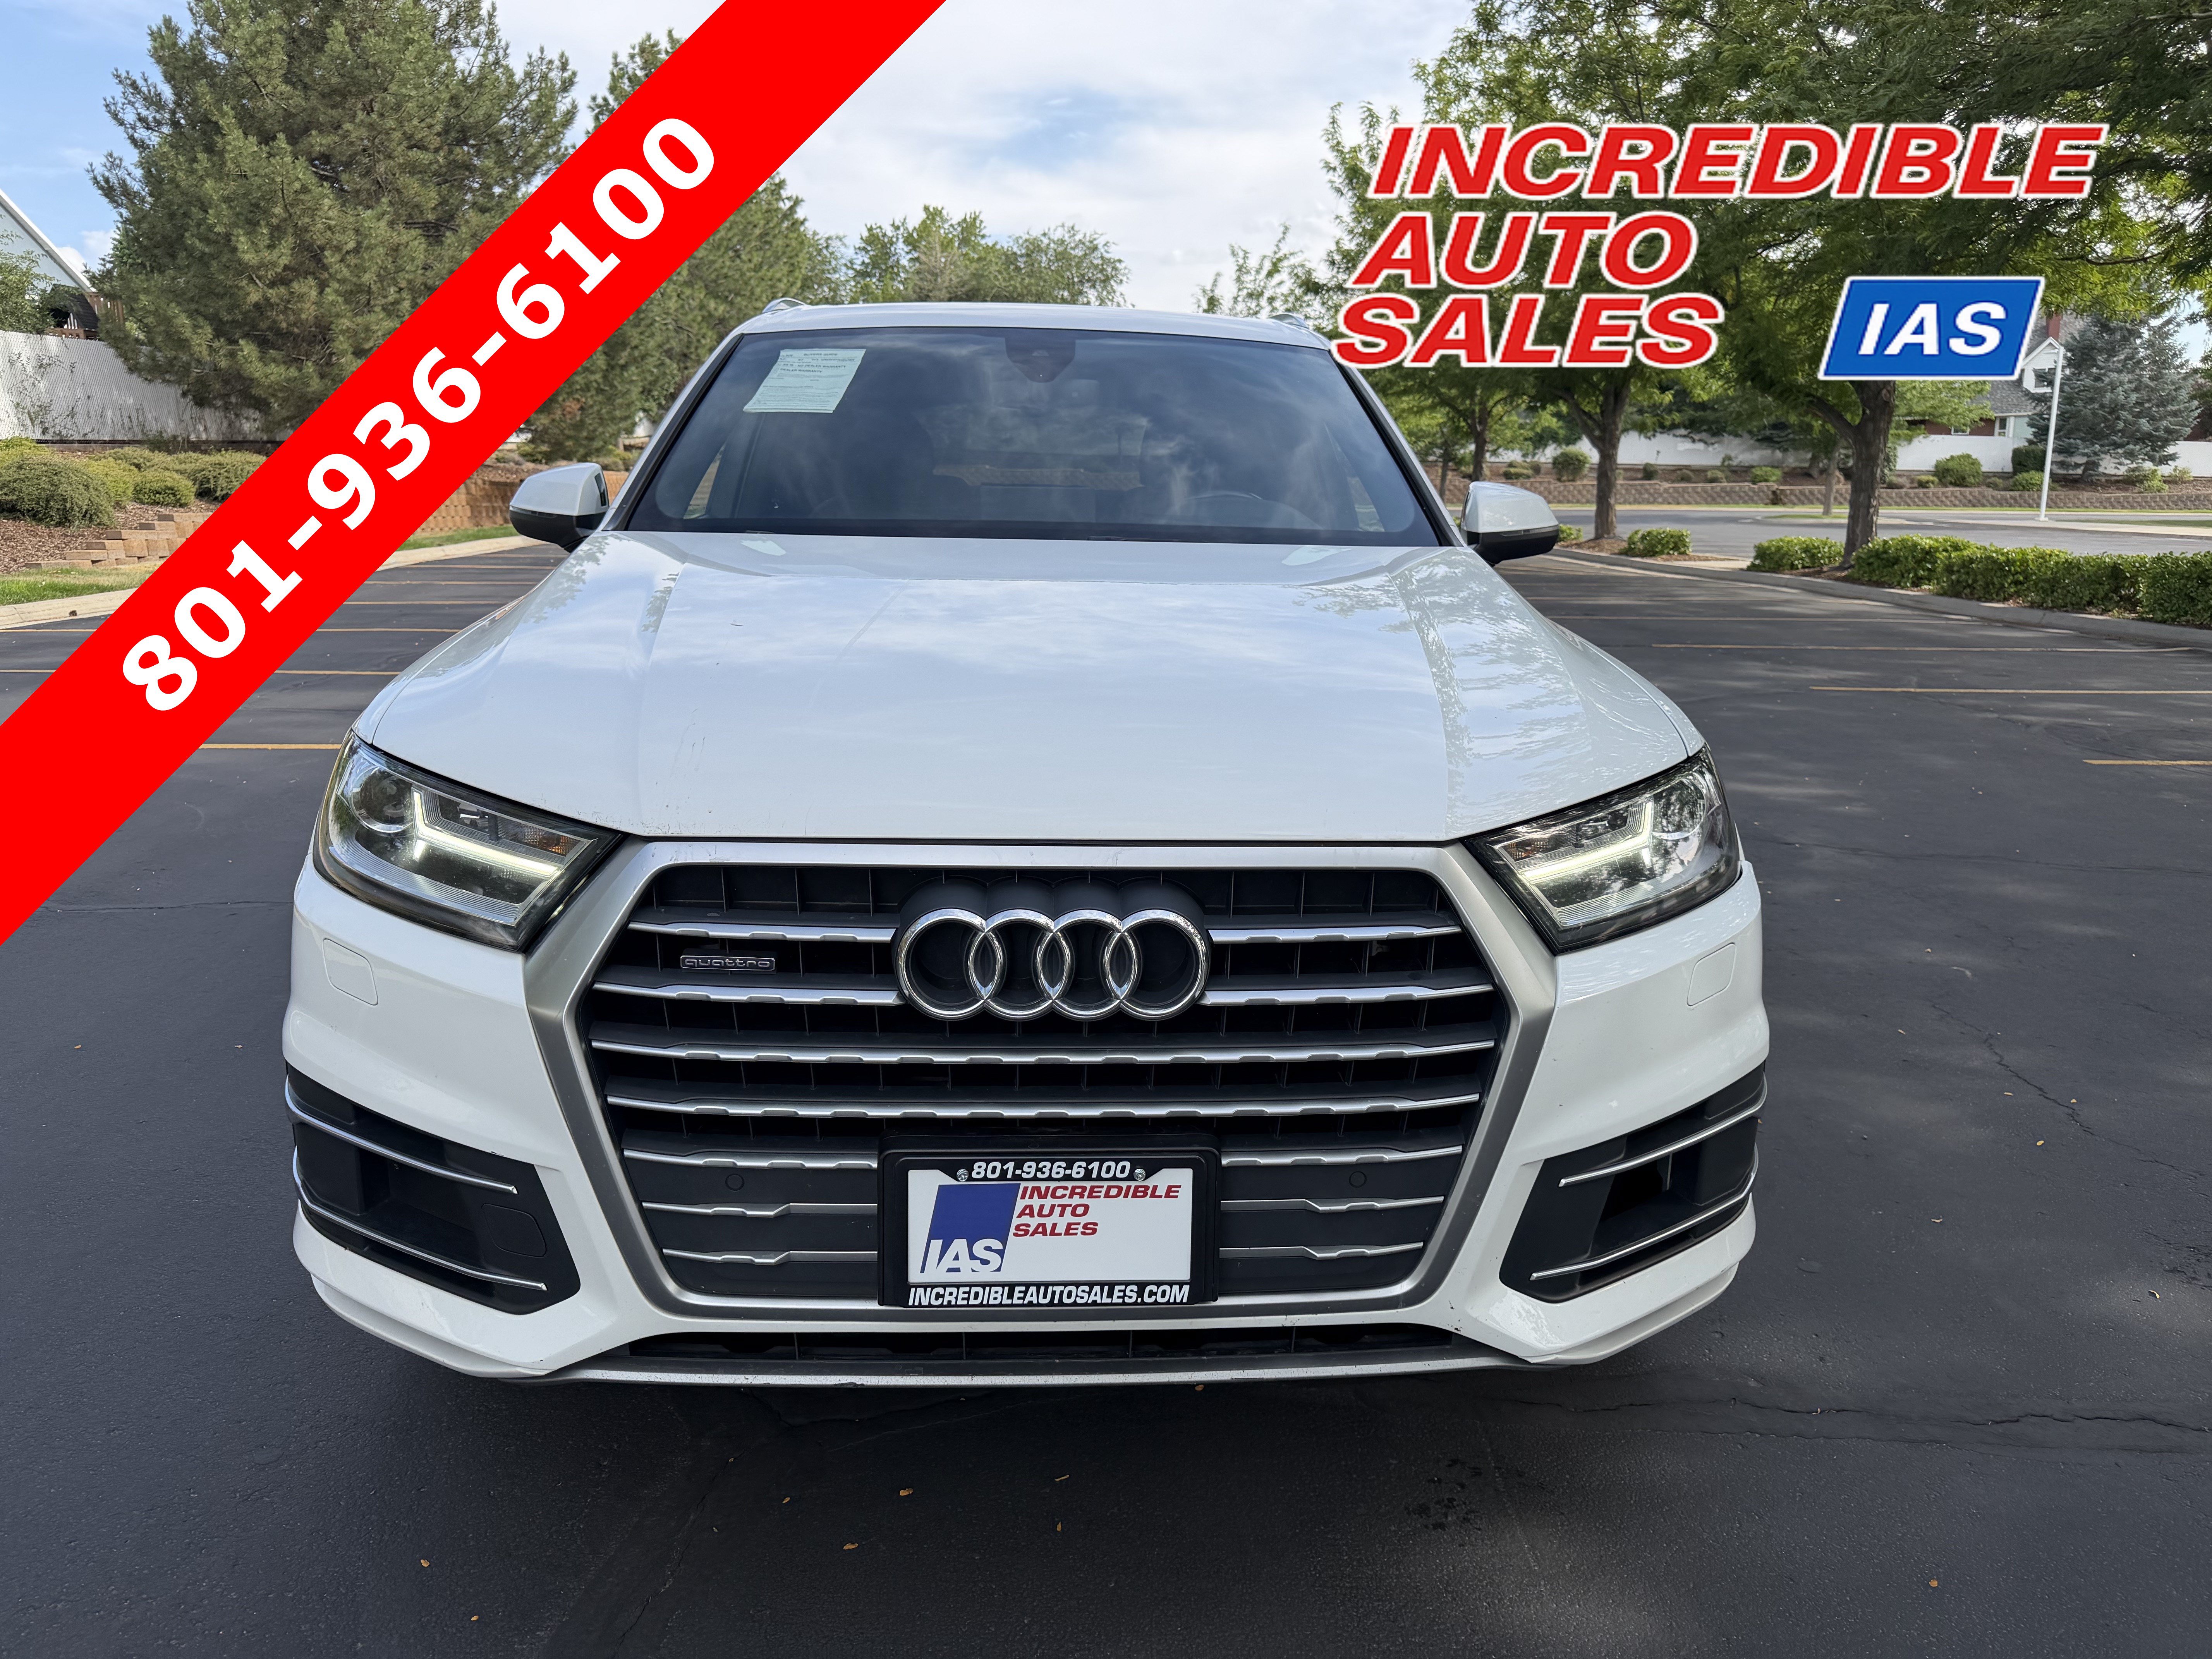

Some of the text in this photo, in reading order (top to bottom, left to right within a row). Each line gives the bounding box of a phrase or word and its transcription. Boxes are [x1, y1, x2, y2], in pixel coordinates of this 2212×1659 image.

[685, 959, 770, 967] quattro
[971, 1161, 1131, 1179] 801-936-6100
[1020, 1185, 1182, 1200] INCREDIBLE
[1016, 1203, 1090, 1218] AUTO
[1013, 1222, 1099, 1237] SALES
[924, 1238, 1003, 1273] IAS
[908, 1285, 1190, 1306] INCREDIBLEAUTOSALES.COM
